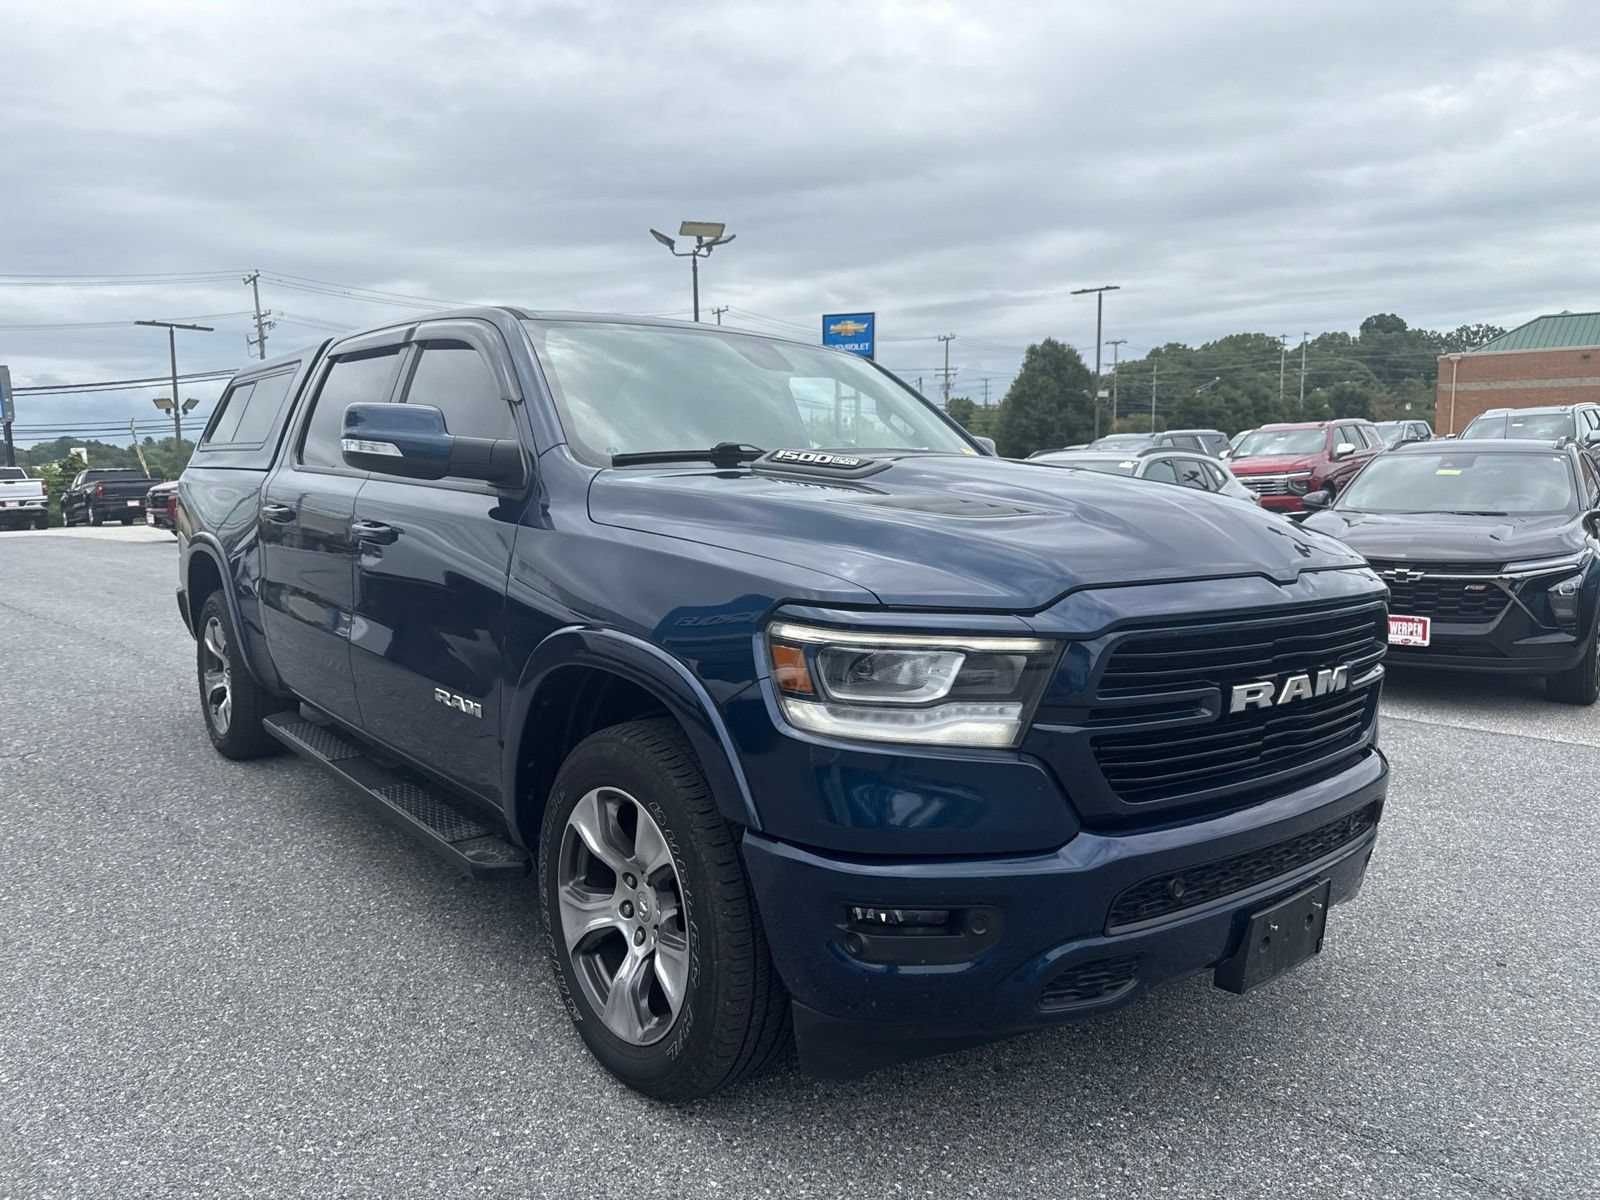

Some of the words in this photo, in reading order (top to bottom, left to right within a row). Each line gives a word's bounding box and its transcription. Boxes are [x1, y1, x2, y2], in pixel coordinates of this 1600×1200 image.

[775, 449, 834, 464] 1500
[434, 687, 482, 719] RAM
[1230, 665, 1348, 713] RAM
[538, 783, 584, 1022] BRIDGESTONE
